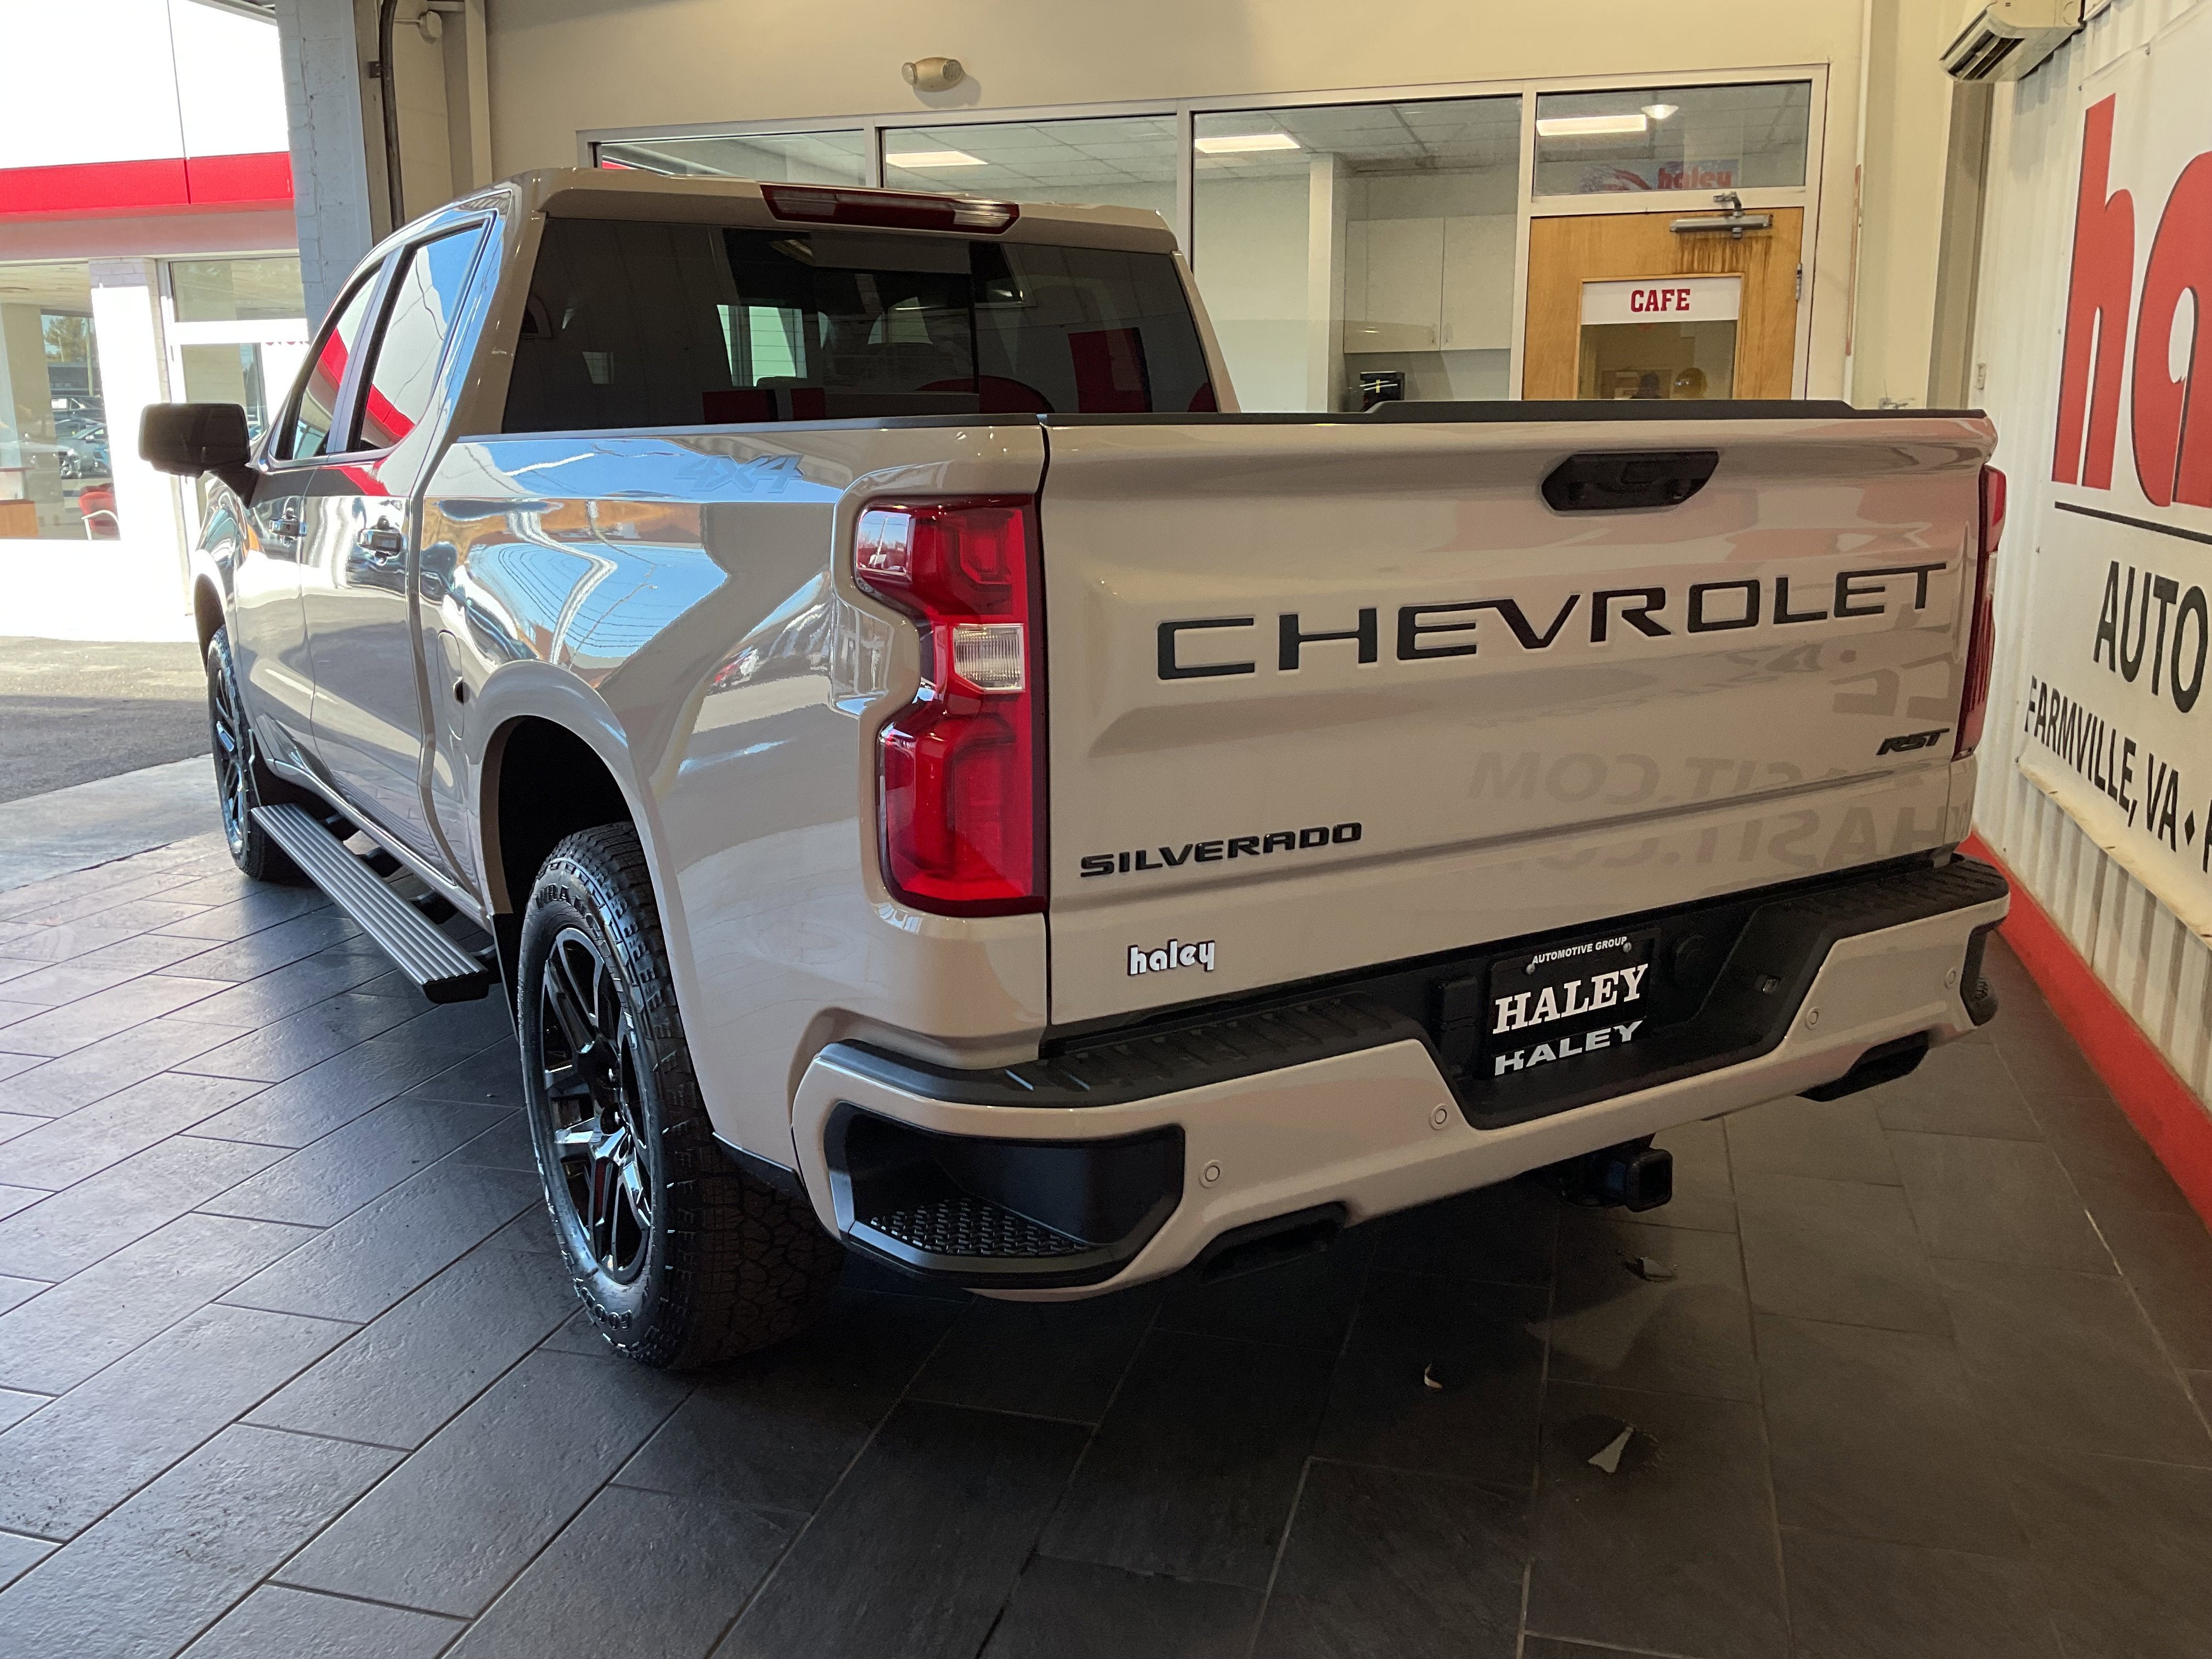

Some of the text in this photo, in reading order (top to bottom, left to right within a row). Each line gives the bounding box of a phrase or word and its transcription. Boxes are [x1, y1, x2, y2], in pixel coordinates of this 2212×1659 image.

[1630, 289, 1690, 312] CAFE
[1158, 563, 1946, 680] CHEVROLET
[2093, 560, 2208, 713] AUTO
[1876, 728, 1950, 755] RST
[2024, 675, 2137, 827] FARMVILLE,
[1080, 822, 1362, 878] SILVERADO
[1127, 939, 1215, 976] haley
[1531, 936, 1628, 965] AUTOMOTIVE GROUP
[1493, 963, 1649, 1034] HALEY
[1495, 1020, 1644, 1076] HALEY
